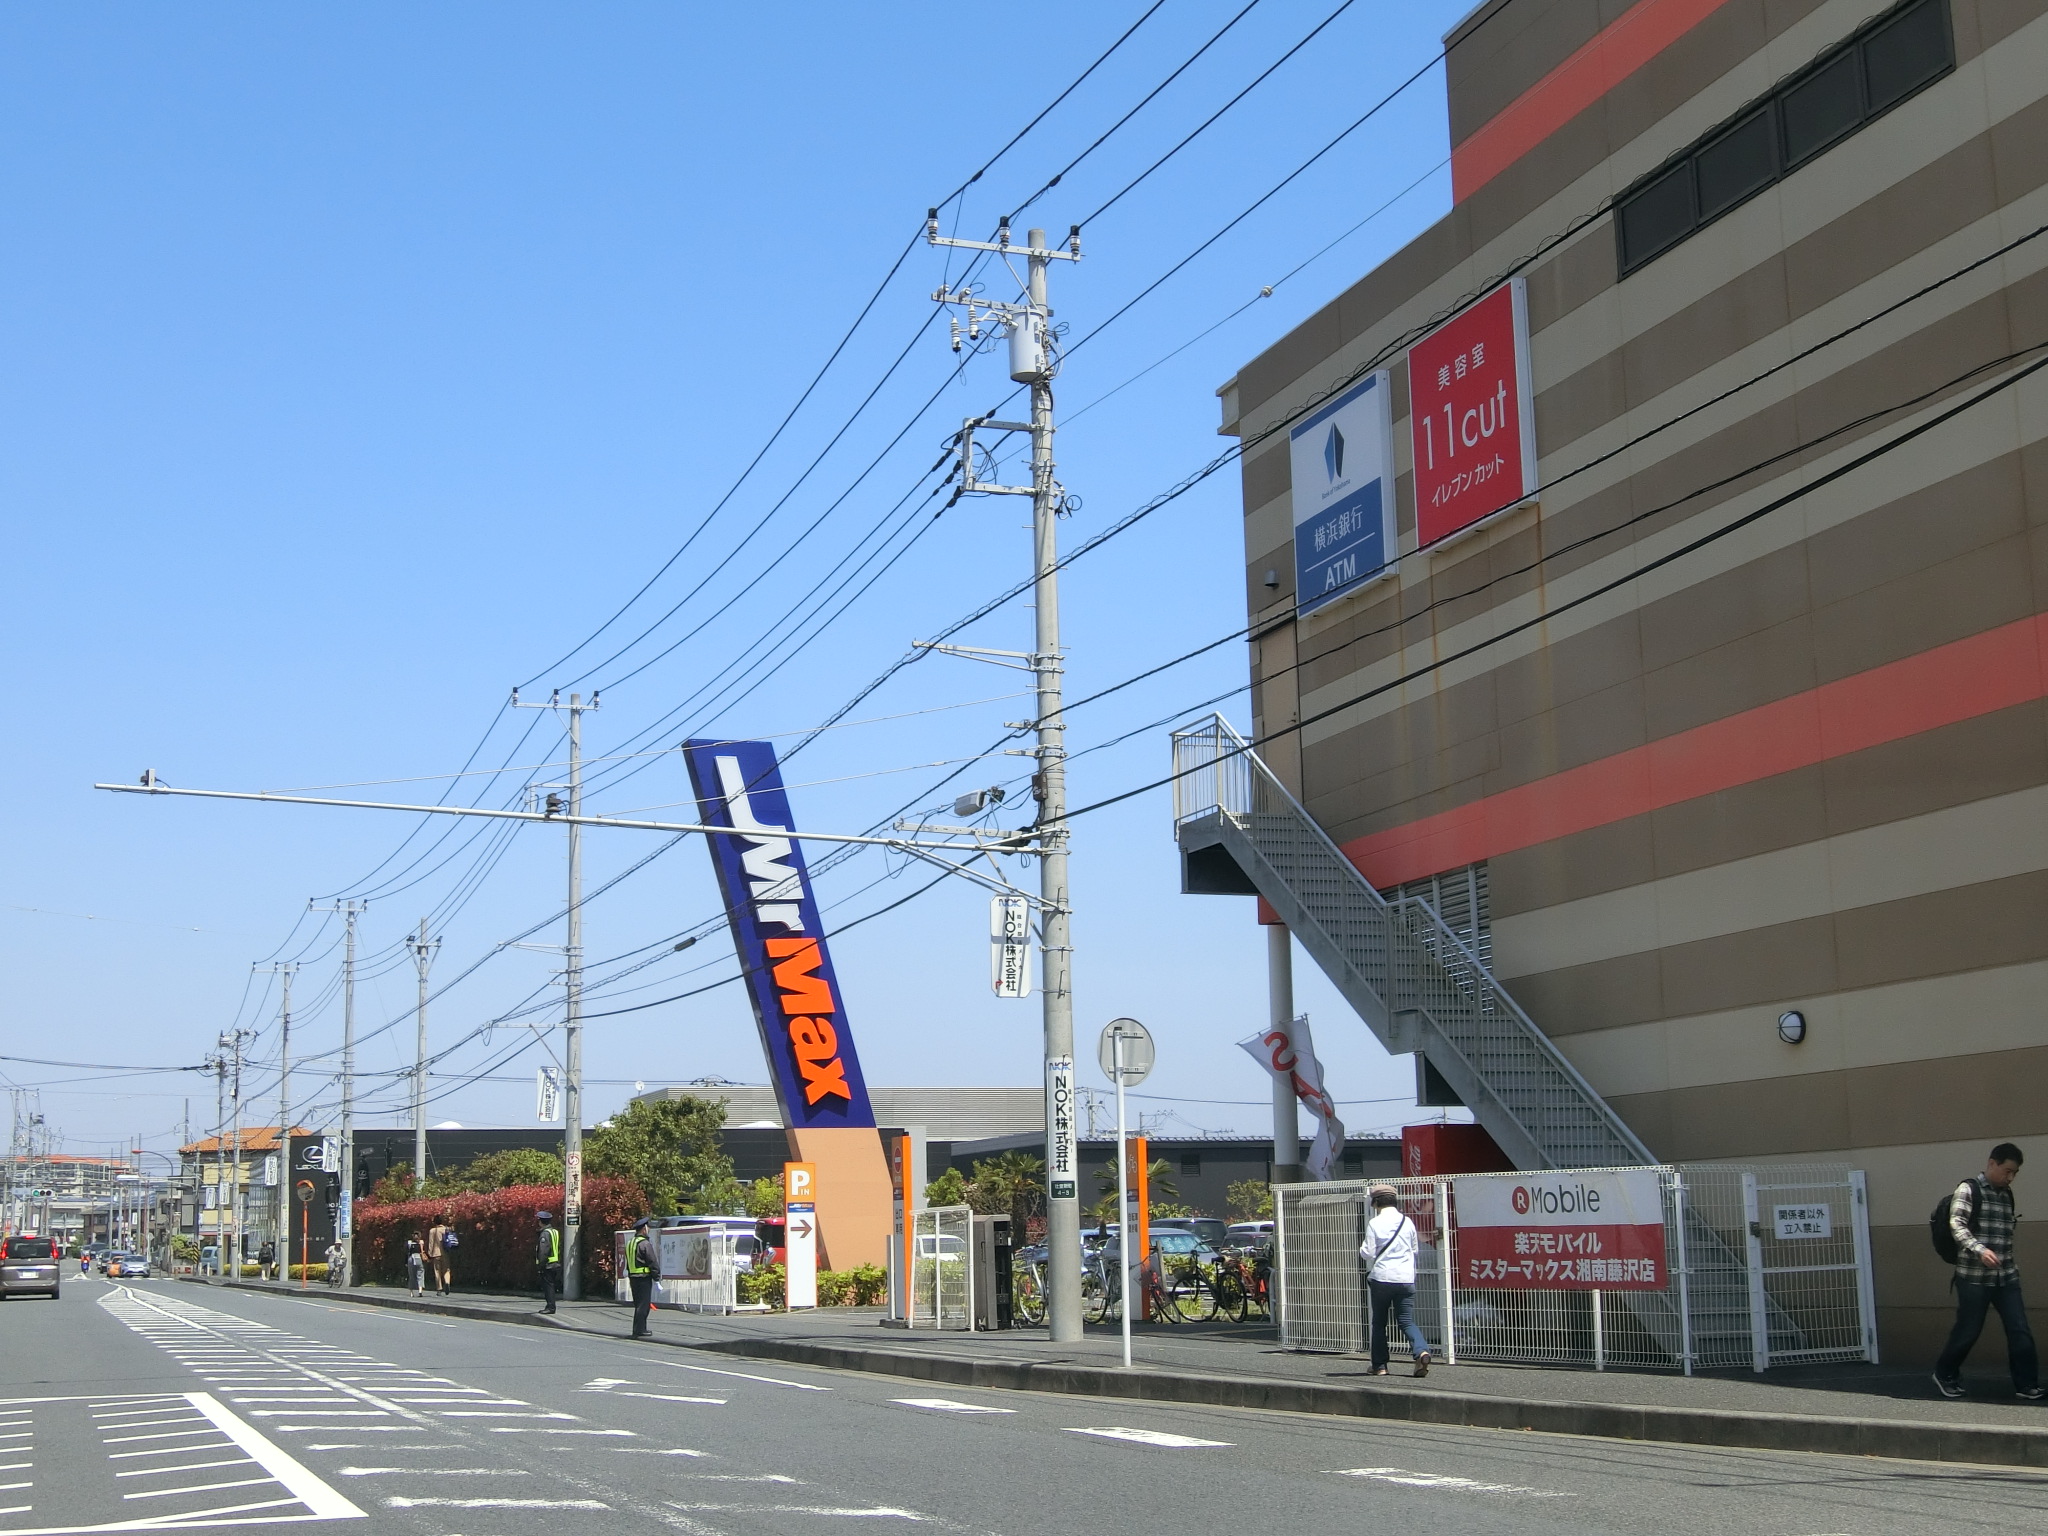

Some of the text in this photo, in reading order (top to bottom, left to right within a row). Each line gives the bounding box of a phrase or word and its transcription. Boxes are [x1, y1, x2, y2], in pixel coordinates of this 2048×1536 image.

[1438, 343, 1485, 391] 美容室
[1422, 379, 1507, 470] 11cut
[1432, 453, 1505, 508] イレブンカット
[1314, 504, 1363, 552] 横浜銀行
[1325, 553, 1356, 590] ATM
[791, 1170, 811, 1196] P
[1531, 1184, 1600, 1214] Mobile
[1778, 1208, 1825, 1220] 関係者以外
[1784, 1222, 1822, 1234] 立入禁止
[1514, 1232, 1602, 1255] 楽天モバイル
[1470, 1258, 1656, 1282] ミスターマックス湘南藤沢店
